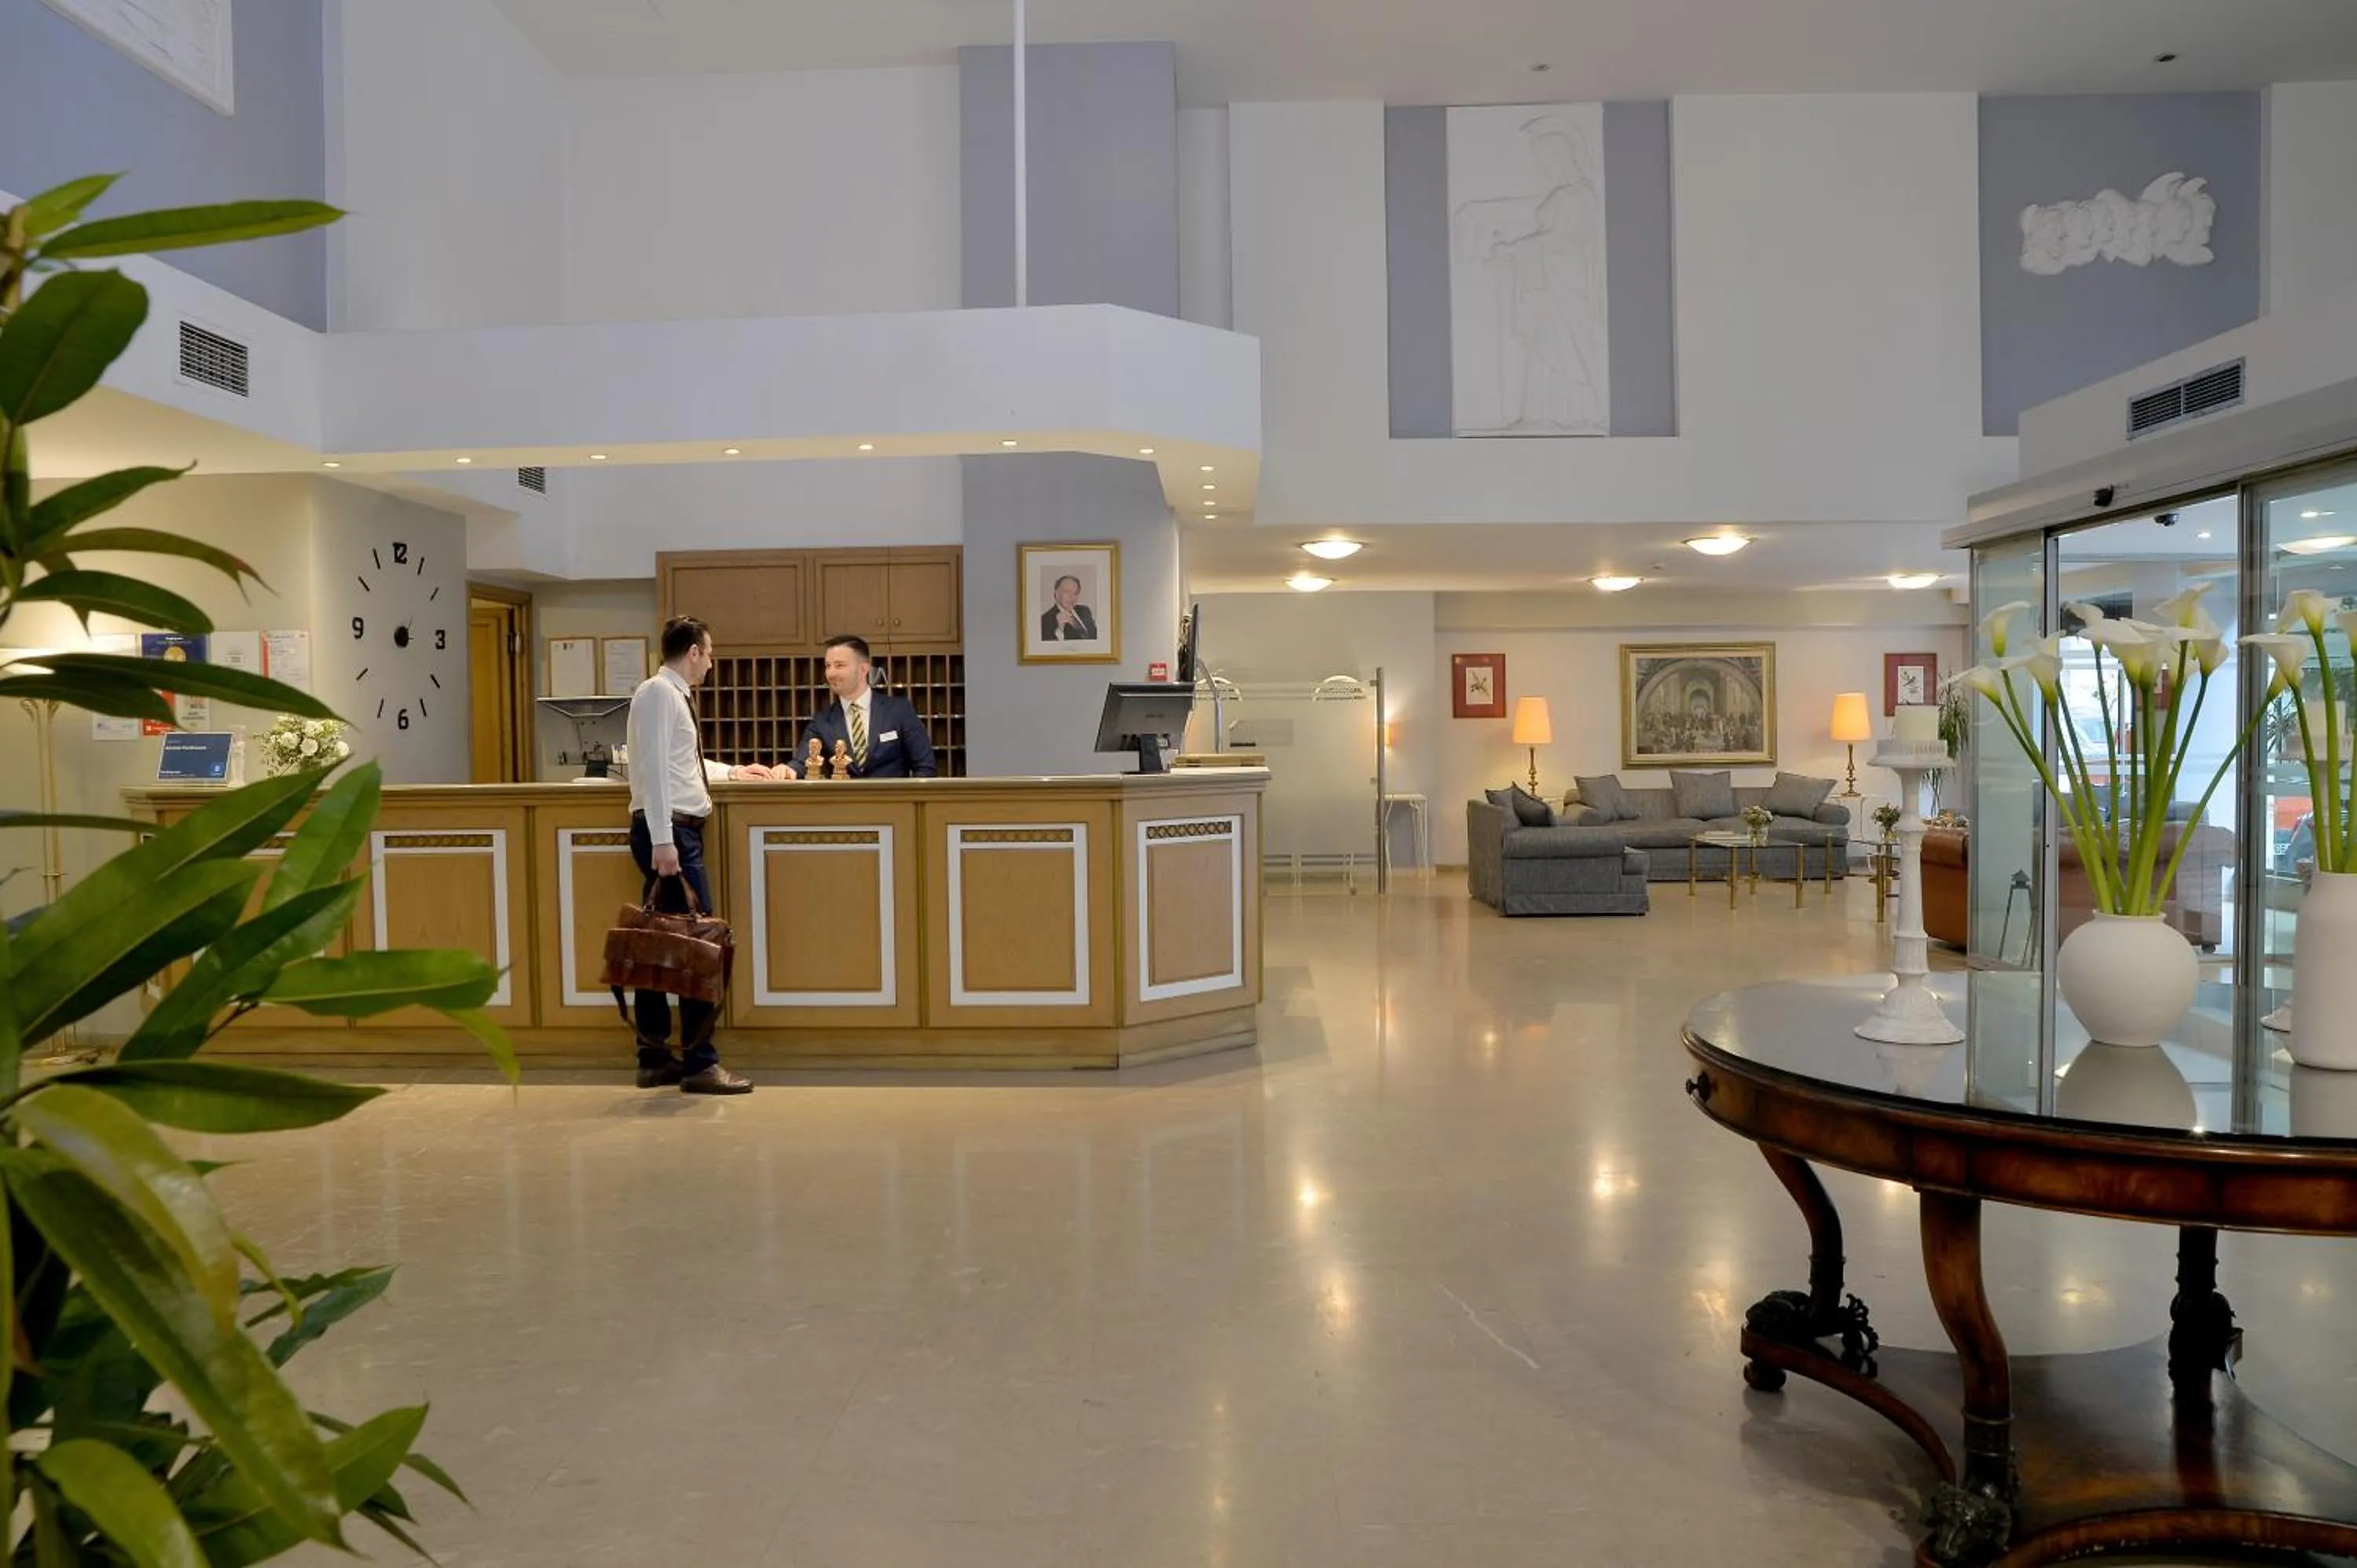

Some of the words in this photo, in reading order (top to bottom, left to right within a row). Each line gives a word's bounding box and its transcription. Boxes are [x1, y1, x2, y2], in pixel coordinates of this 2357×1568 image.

[392, 542, 408, 564] 12
[352, 617, 364, 639] 9
[435, 629, 445, 650] 3
[398, 709, 409, 729] 6
